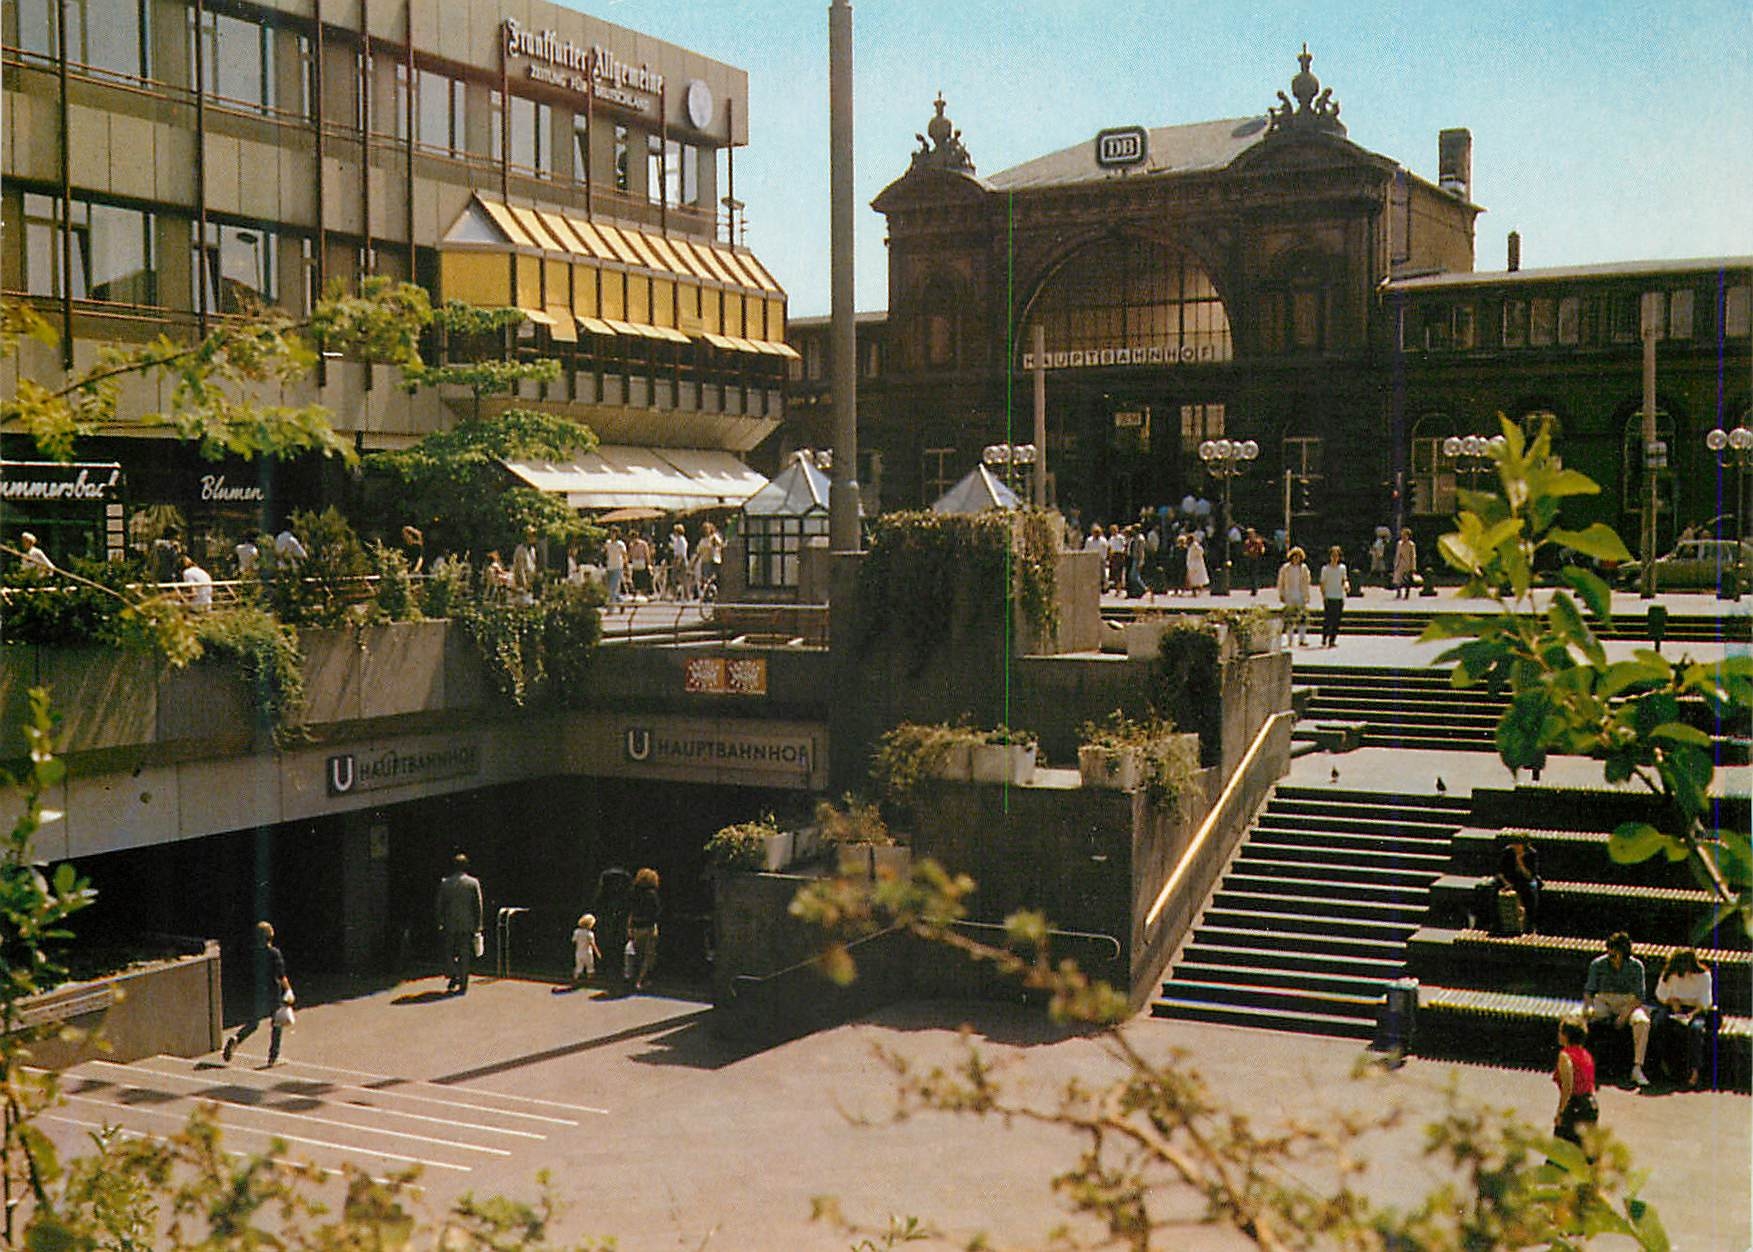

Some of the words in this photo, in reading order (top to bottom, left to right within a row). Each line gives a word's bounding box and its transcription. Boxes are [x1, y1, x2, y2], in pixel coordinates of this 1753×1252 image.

[508, 17, 588, 72] Frankfurter
[593, 43, 664, 95] Allgemeine
[1024, 347, 1211, 369] HAUPTBAHNHOF
[200, 474, 265, 500] Blumen
[627, 729, 650, 761] U
[657, 738, 807, 763] HAUPTBAHNHOF
[333, 756, 354, 792] U
